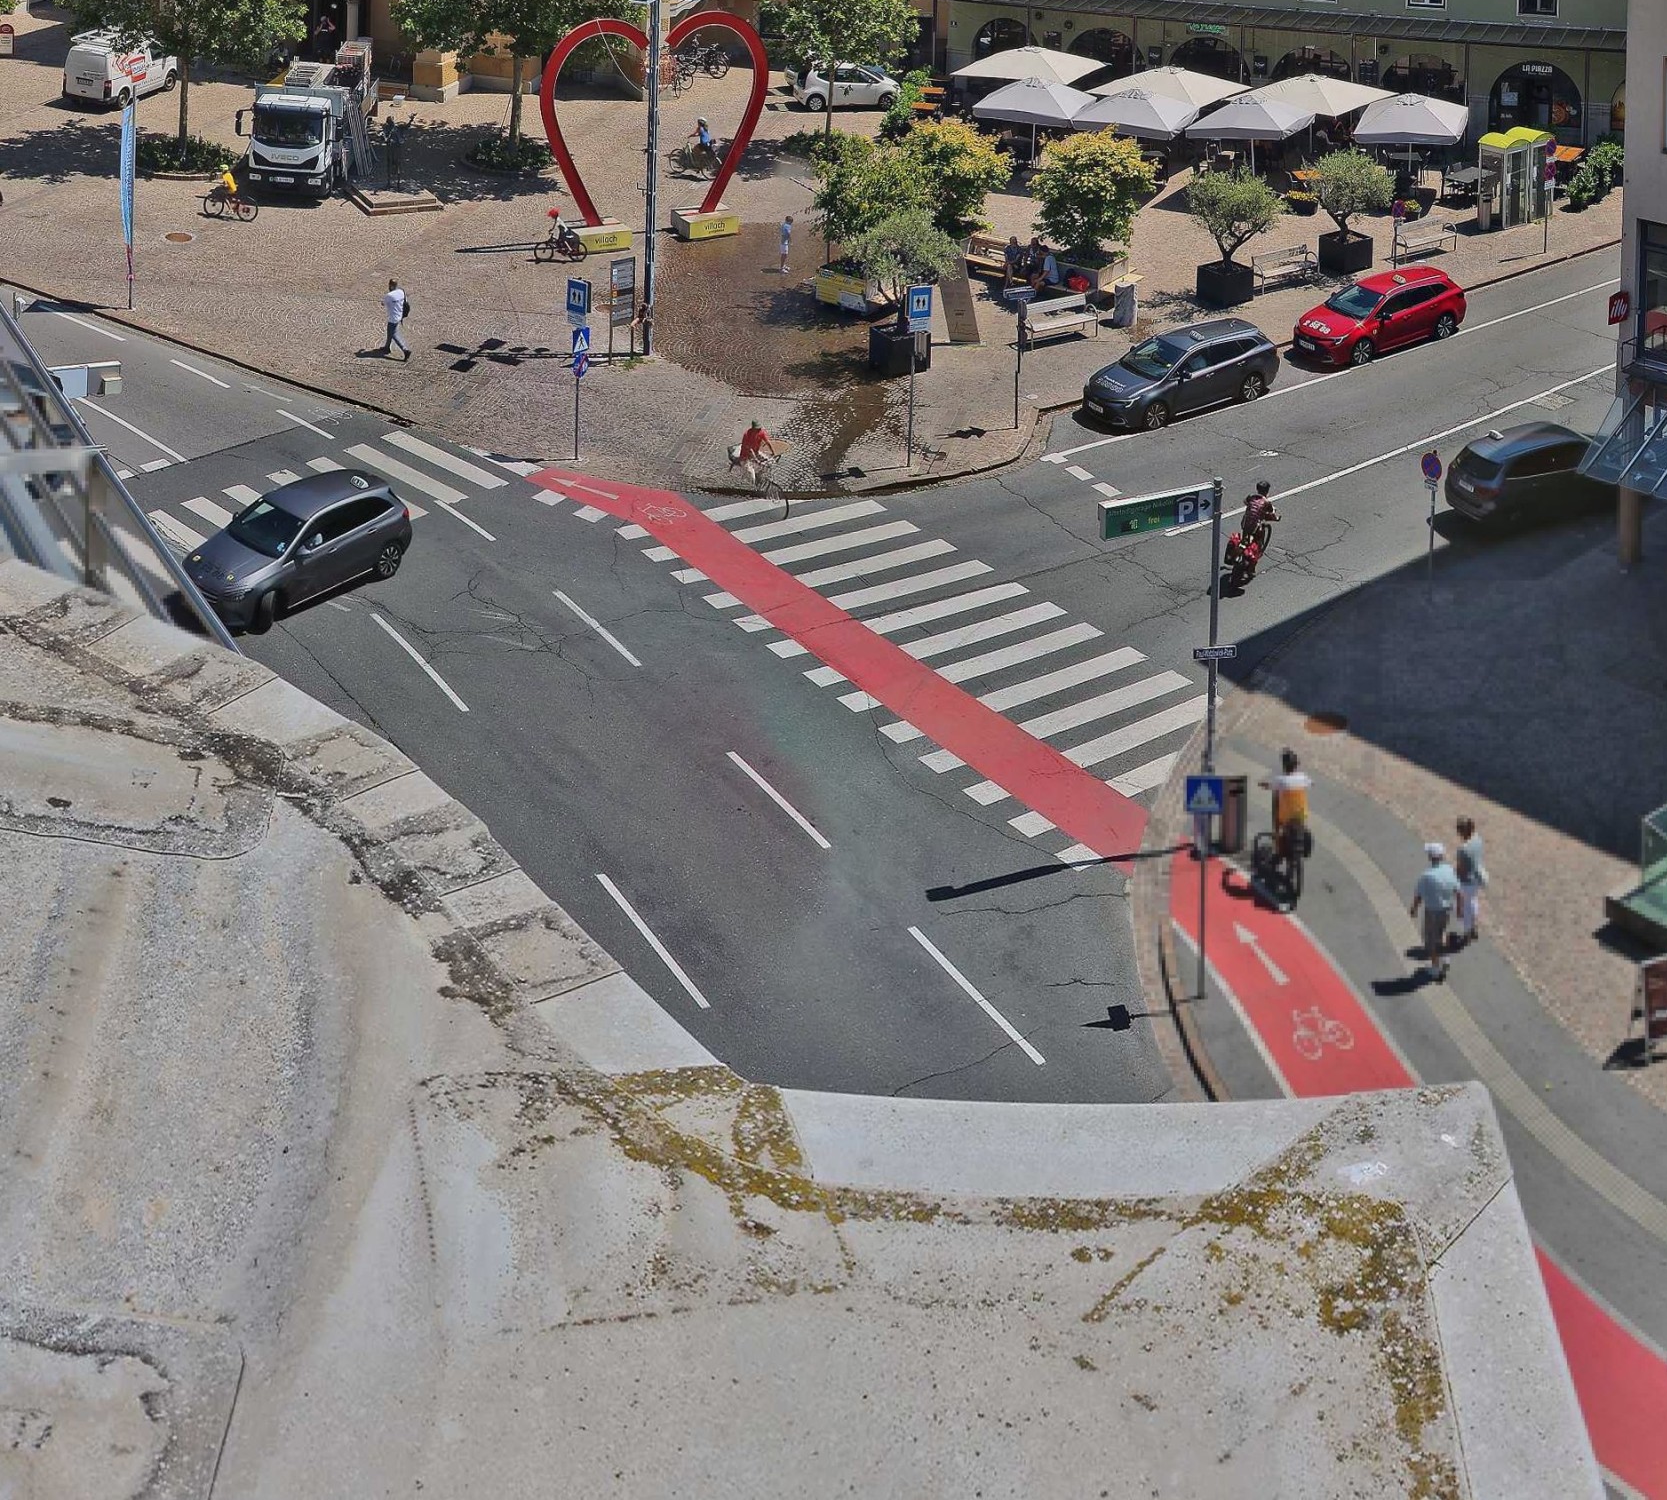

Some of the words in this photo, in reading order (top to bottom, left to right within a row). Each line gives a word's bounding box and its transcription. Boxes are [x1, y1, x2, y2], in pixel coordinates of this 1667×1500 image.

[1522, 64, 1531, 72] LA
[1532, 65, 1553, 73] PIAZZA
[1610, 298, 1628, 320] illy
[1148, 516, 1160, 525] frei
